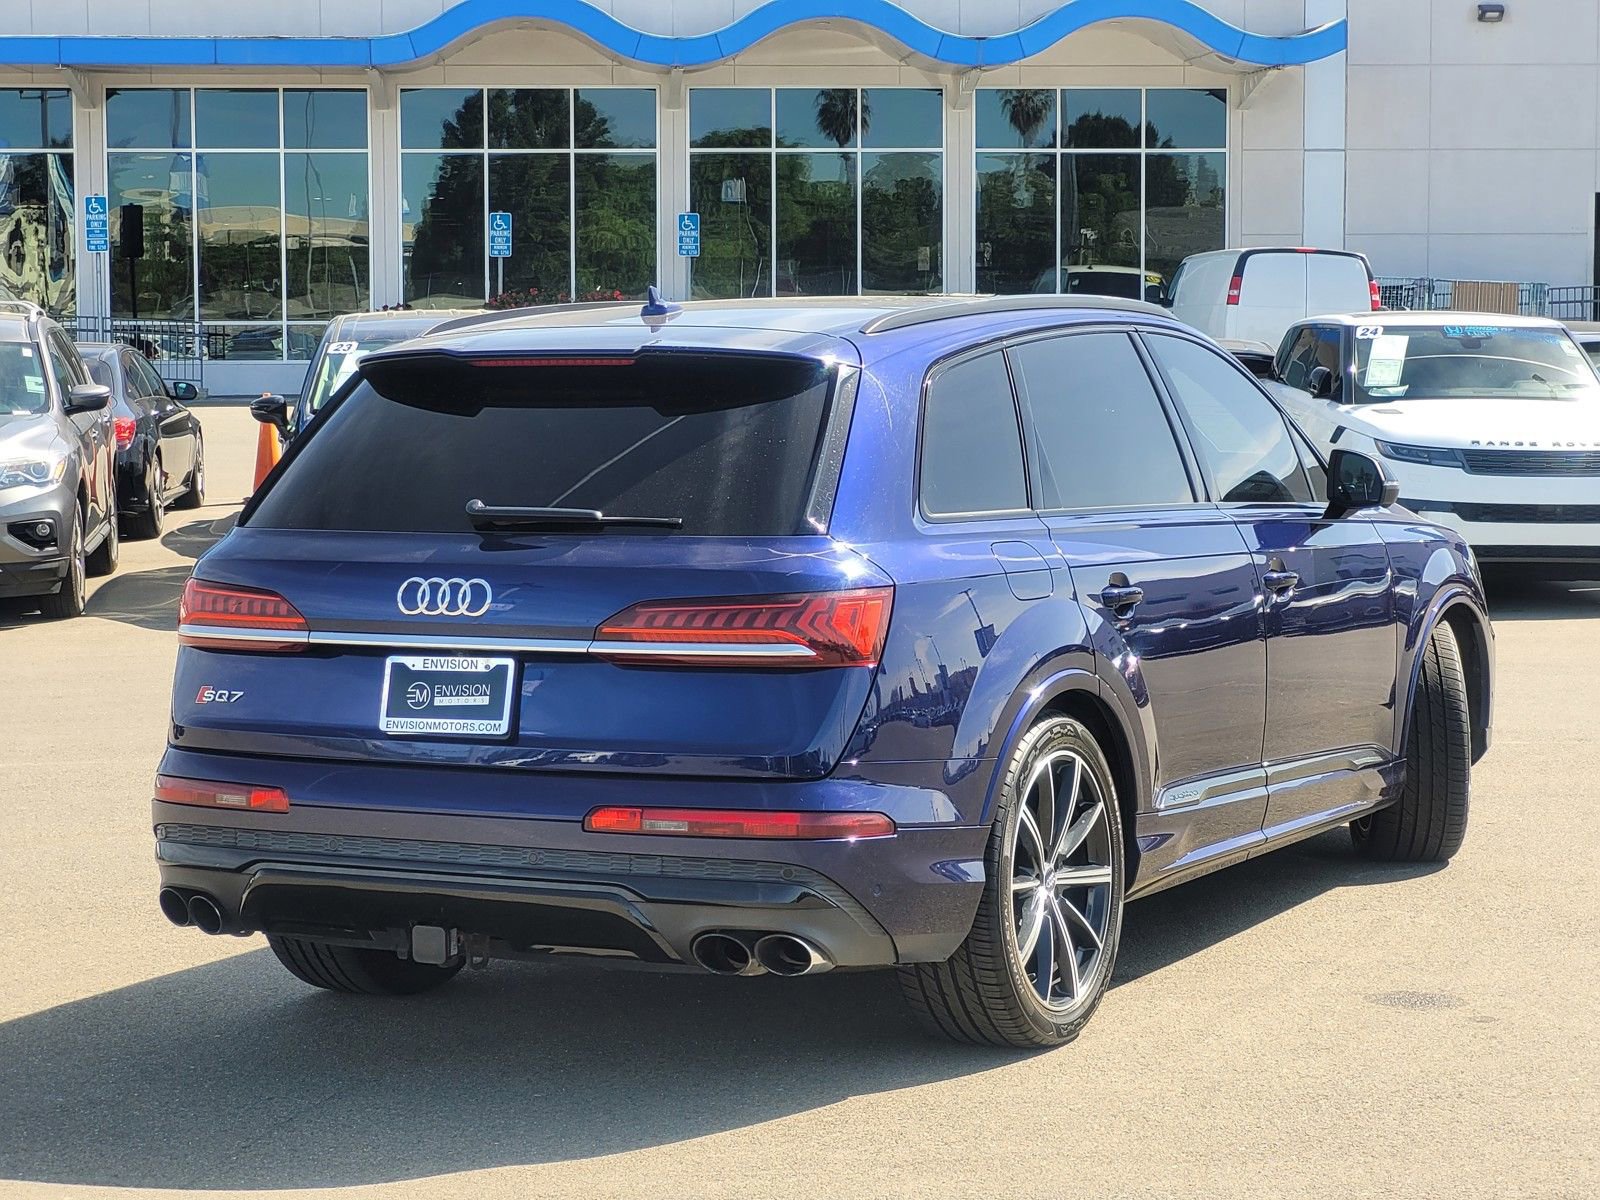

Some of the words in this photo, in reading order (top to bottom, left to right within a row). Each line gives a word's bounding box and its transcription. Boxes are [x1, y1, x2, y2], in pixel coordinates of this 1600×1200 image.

[1360, 327, 1379, 336] 24
[333, 343, 353, 352] 23
[422, 658, 479, 670] ENVISION
[199, 688, 244, 703] SQ7
[434, 684, 491, 697] ENVISION
[385, 719, 502, 733] ENVISIONMOTORS.COM
